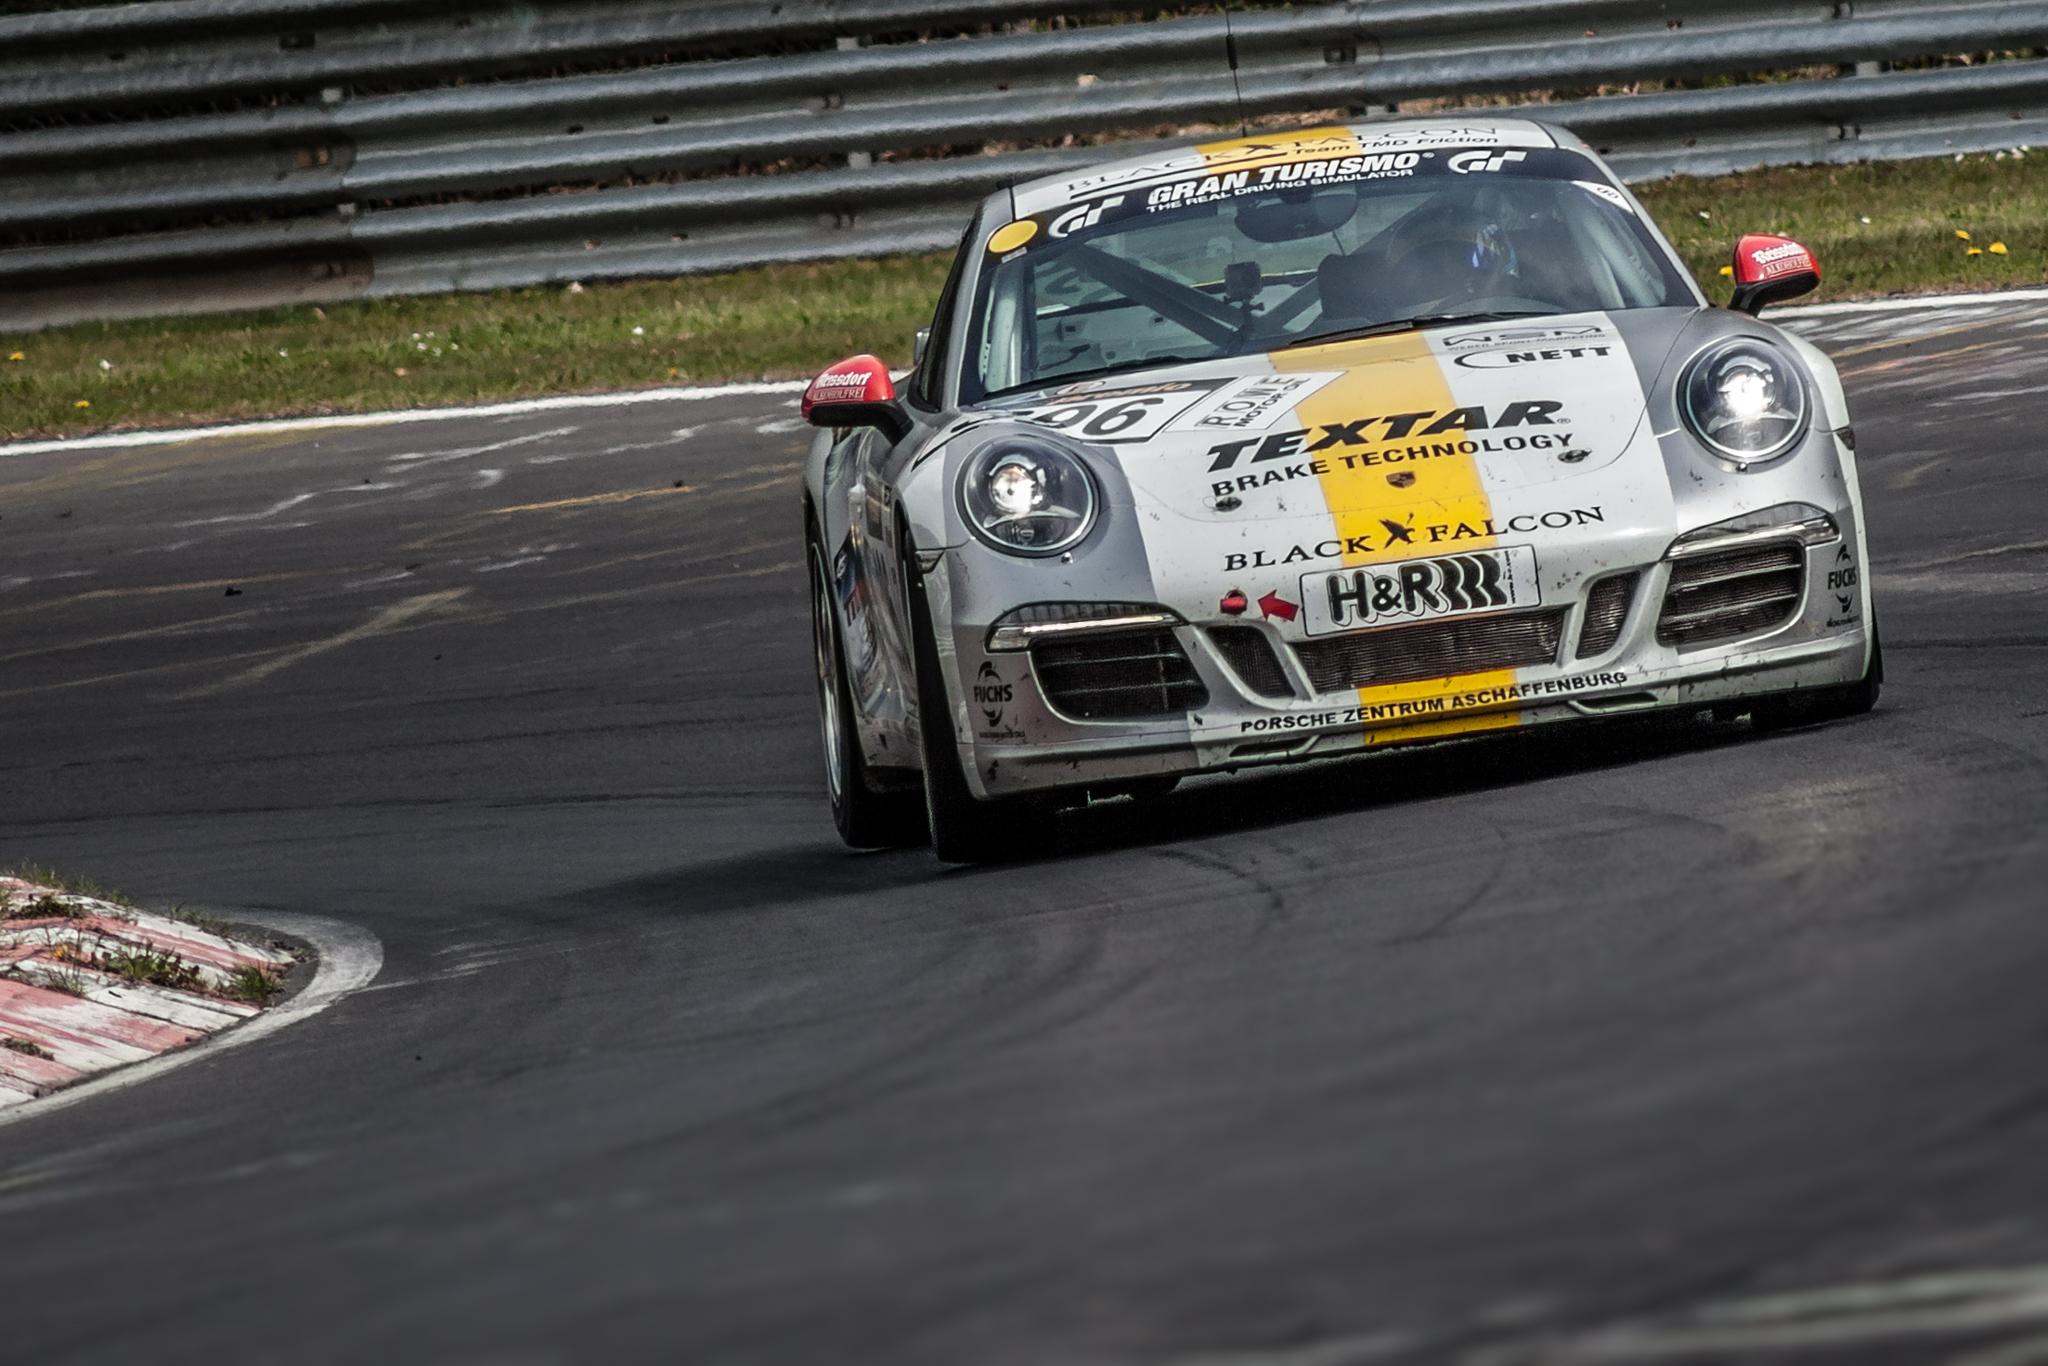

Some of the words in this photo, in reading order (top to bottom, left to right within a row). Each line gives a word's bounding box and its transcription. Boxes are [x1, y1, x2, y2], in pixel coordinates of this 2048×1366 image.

[1067, 153, 1235, 192] BLACK
[1292, 127, 1496, 148] FALCON
[1296, 144, 1351, 155] Team
[1360, 138, 1409, 149] TMD
[1416, 136, 1499, 145] Friction
[1146, 170, 1250, 206] GRAN
[1259, 152, 1421, 183] TURISMO
[1146, 200, 1182, 213] THE
[1182, 191, 1232, 207] REAL
[1233, 179, 1307, 198] DRIVING
[1309, 168, 1414, 186] SIMULATOR
[1505, 346, 1612, 363] NETT
[1013, 397, 1164, 437] 96
[1233, 391, 1288, 428] MOTOR
[1206, 400, 1563, 474] TEXTAR
[1211, 459, 1331, 497] BRAKE
[1338, 433, 1573, 470] TECHNOLOGY
[1224, 535, 1374, 573] BLACK
[1426, 506, 1606, 543] FALCON
[973, 683, 1013, 703] FUCHS
[1240, 711, 1338, 734] PORSCHE
[1343, 698, 1444, 723] ZENTRUM
[1451, 671, 1628, 709] ASCHAFFENBURG
